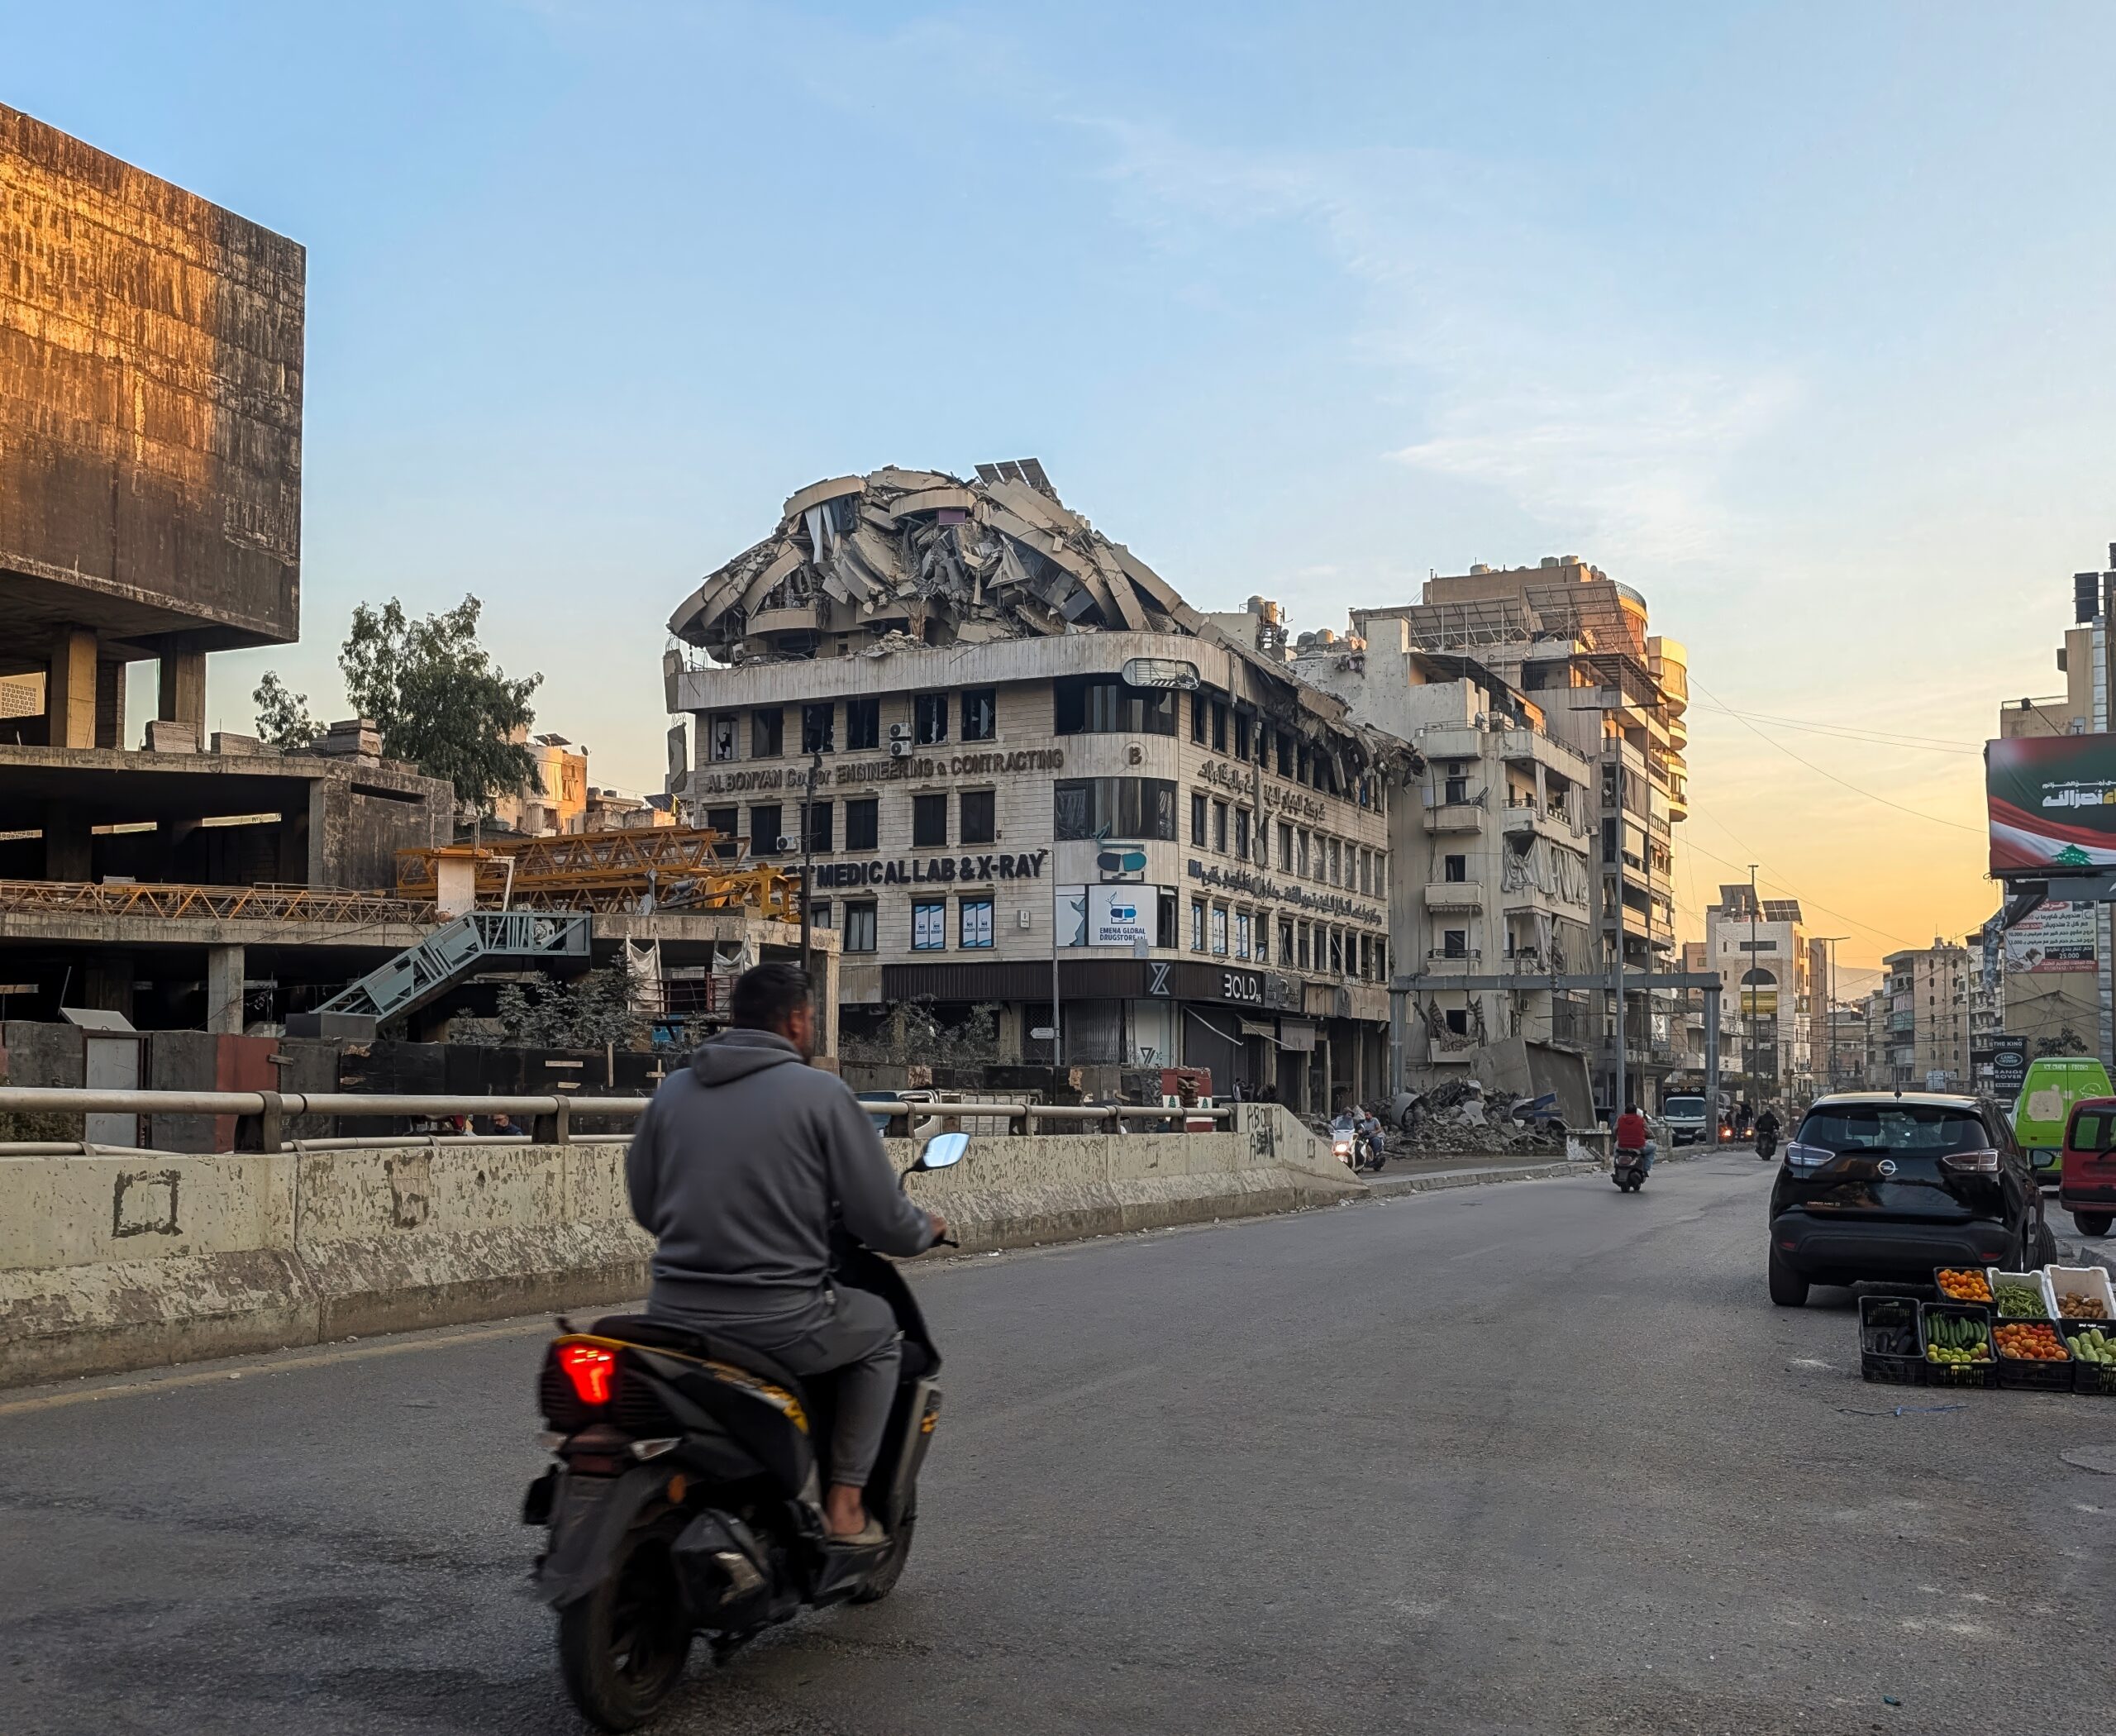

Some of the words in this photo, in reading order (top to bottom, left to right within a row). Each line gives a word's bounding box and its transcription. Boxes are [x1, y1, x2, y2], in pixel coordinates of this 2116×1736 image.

[836, 758, 934, 784] ENGINEERING
[936, 762, 947, 775] &
[951, 748, 1065, 775] CONTRACTING
[817, 860, 911, 888] MEDICAL
[913, 857, 956, 882] LAB
[959, 856, 975, 880] &
[976, 852, 1046, 880] X-RAY
